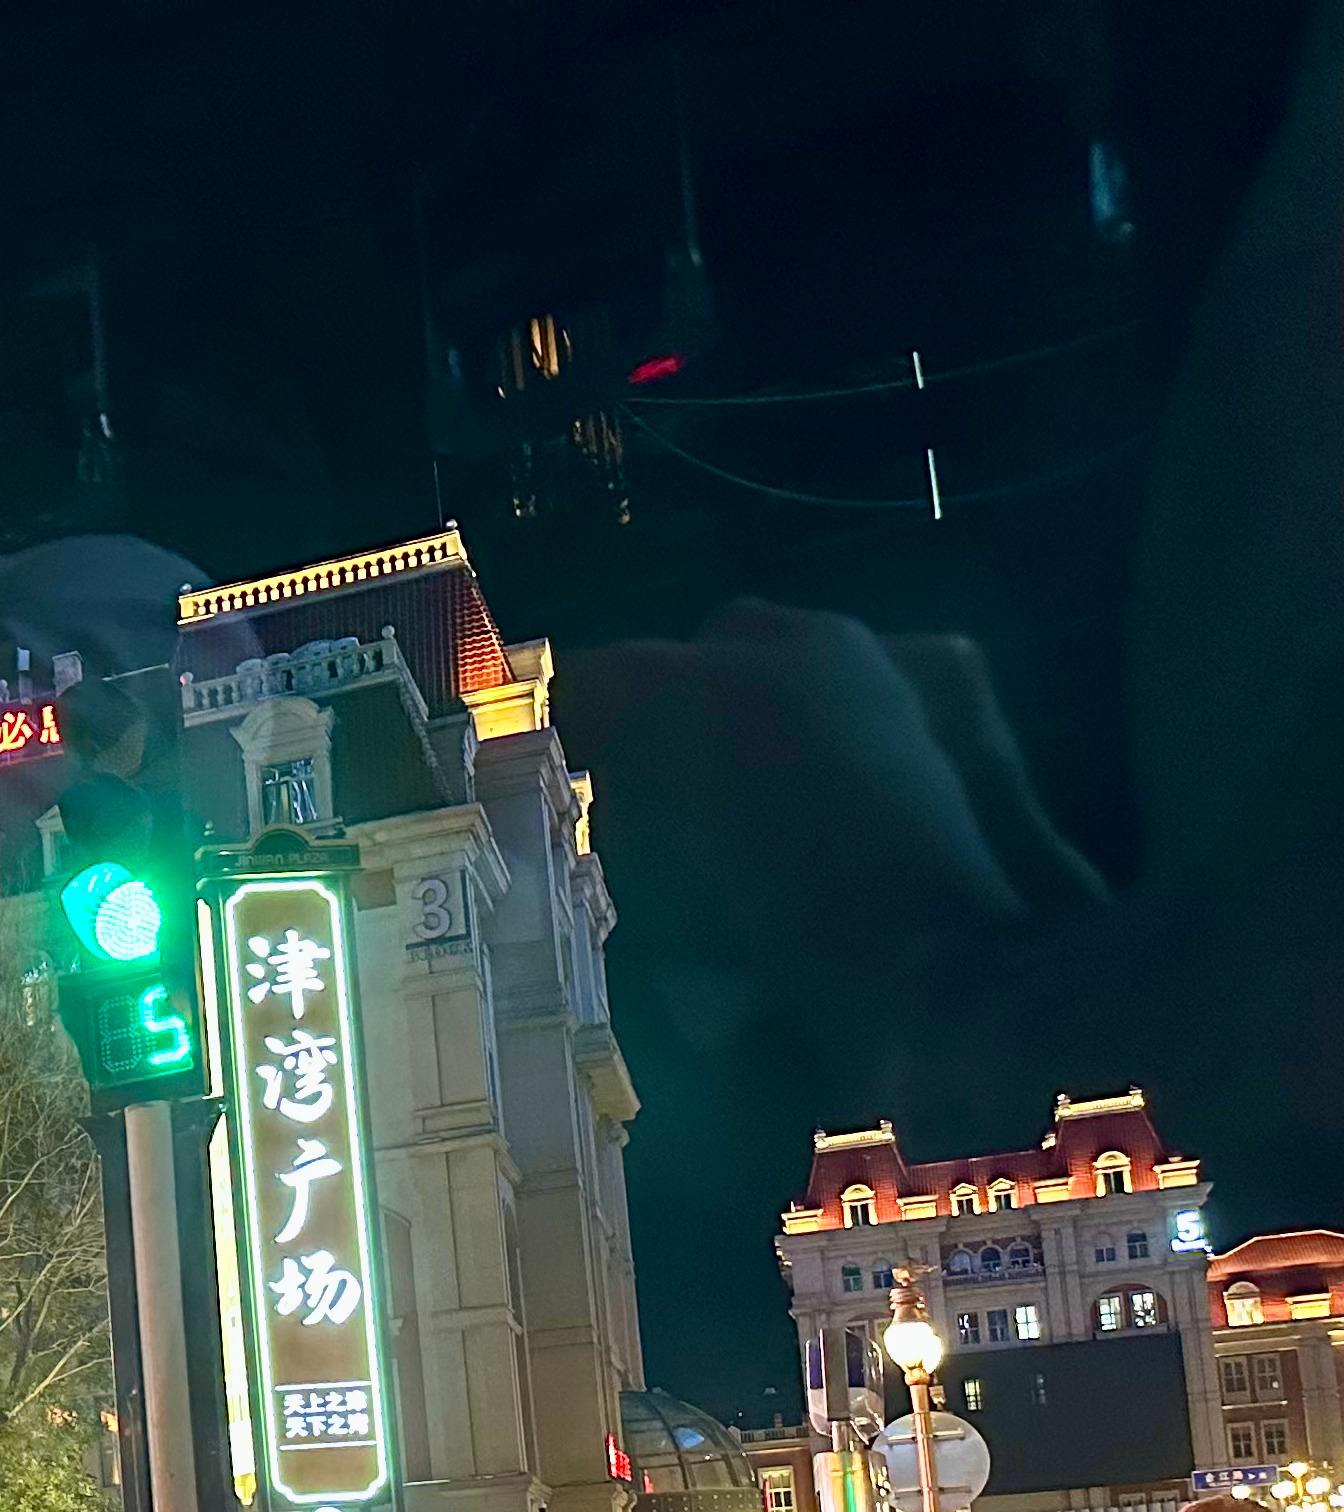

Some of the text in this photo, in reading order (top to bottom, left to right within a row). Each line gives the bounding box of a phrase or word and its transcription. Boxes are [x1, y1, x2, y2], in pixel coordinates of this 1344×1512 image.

[414, 877, 453, 940] 3
[243, 927, 362, 1327] 津湾广场
